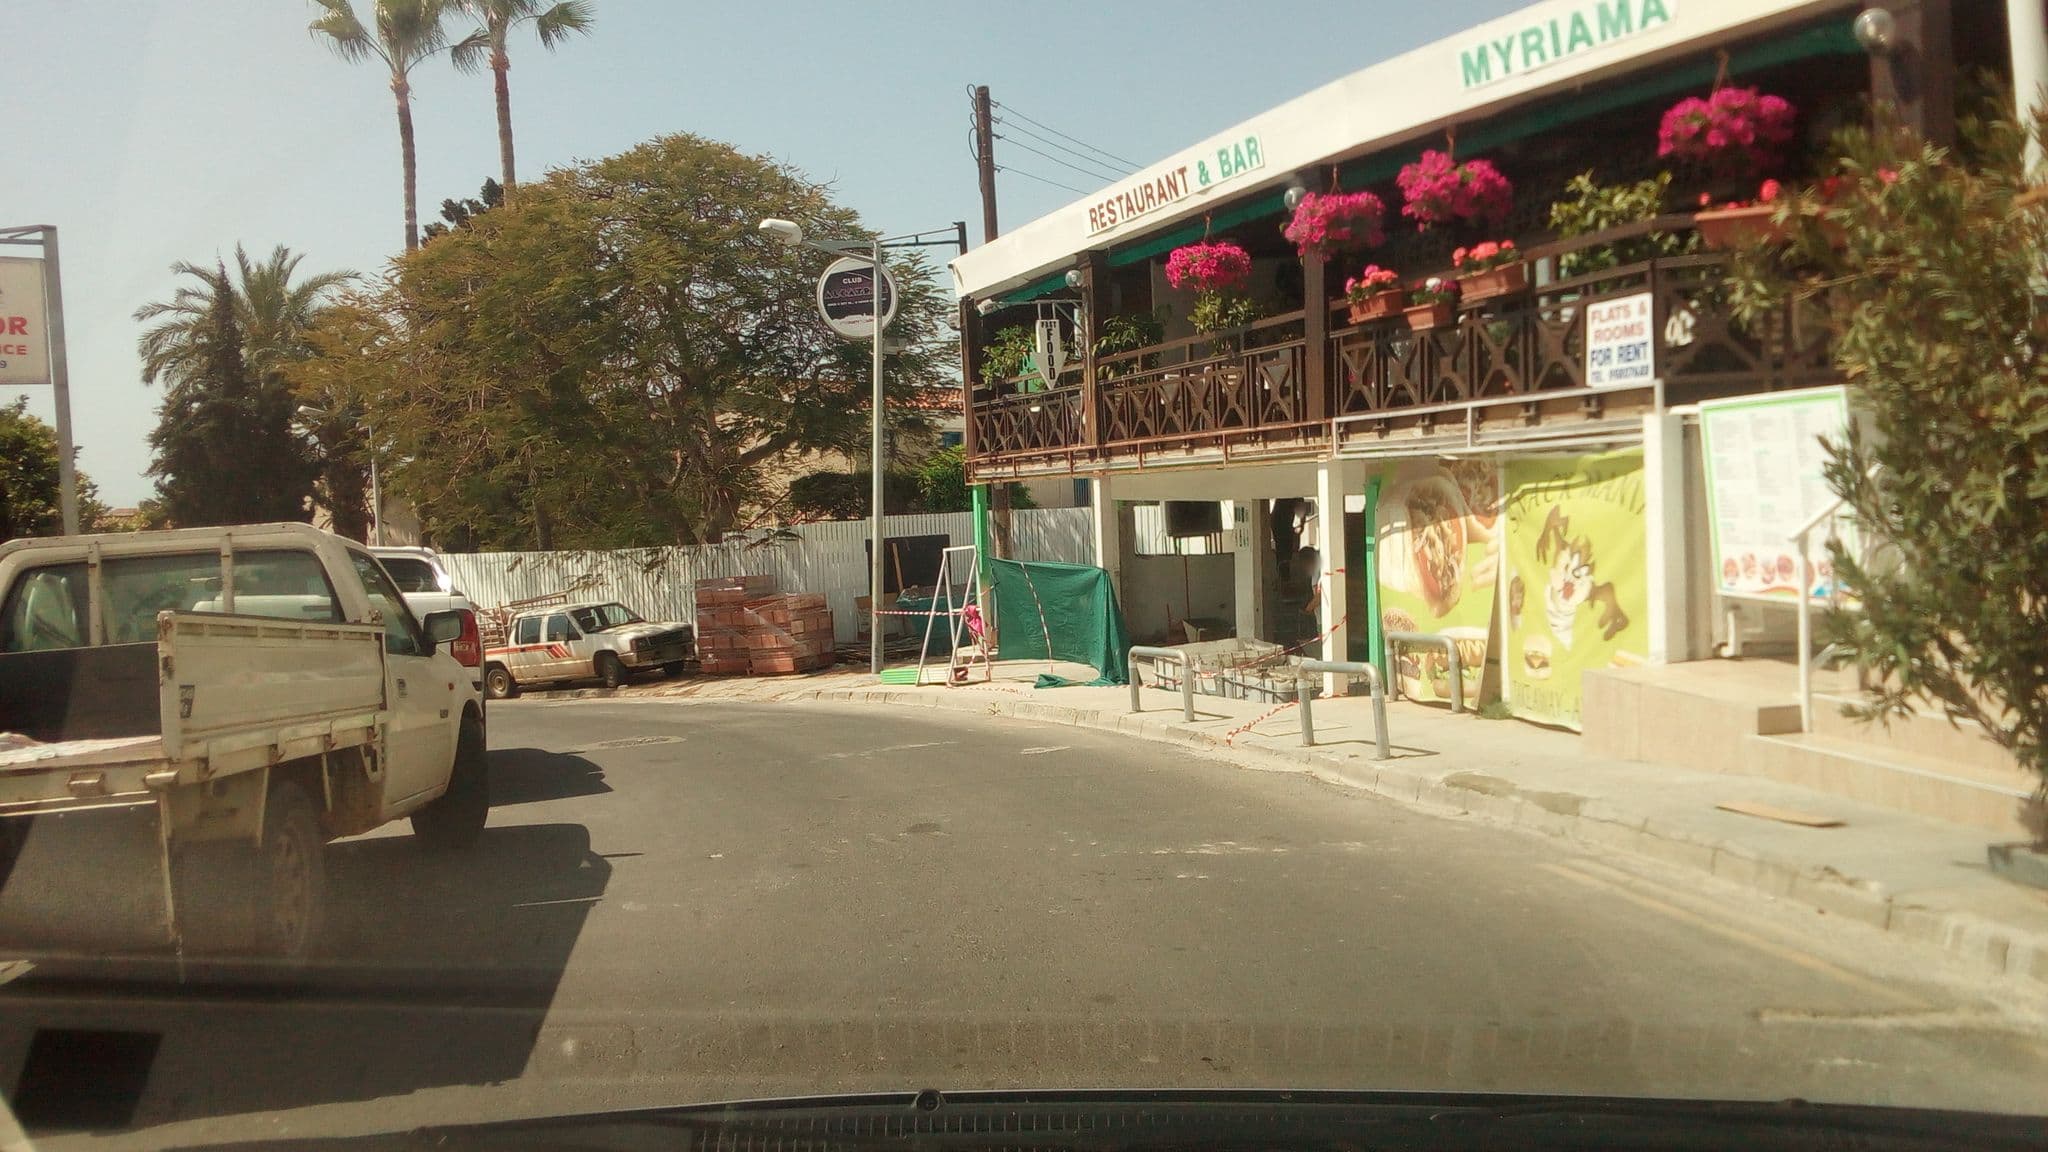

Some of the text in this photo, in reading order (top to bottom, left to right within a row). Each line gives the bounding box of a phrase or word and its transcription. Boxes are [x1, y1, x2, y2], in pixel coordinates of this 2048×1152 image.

[1461, 0, 1669, 87] MYRIAMA
[1089, 136, 1261, 232] RESTAURANT & BAR
[1591, 304, 1631, 324] FLATS
[1594, 321, 1645, 344] ROOMS
[1046, 329, 1056, 380] FOOD
[1590, 341, 1649, 368] FOR RENT
